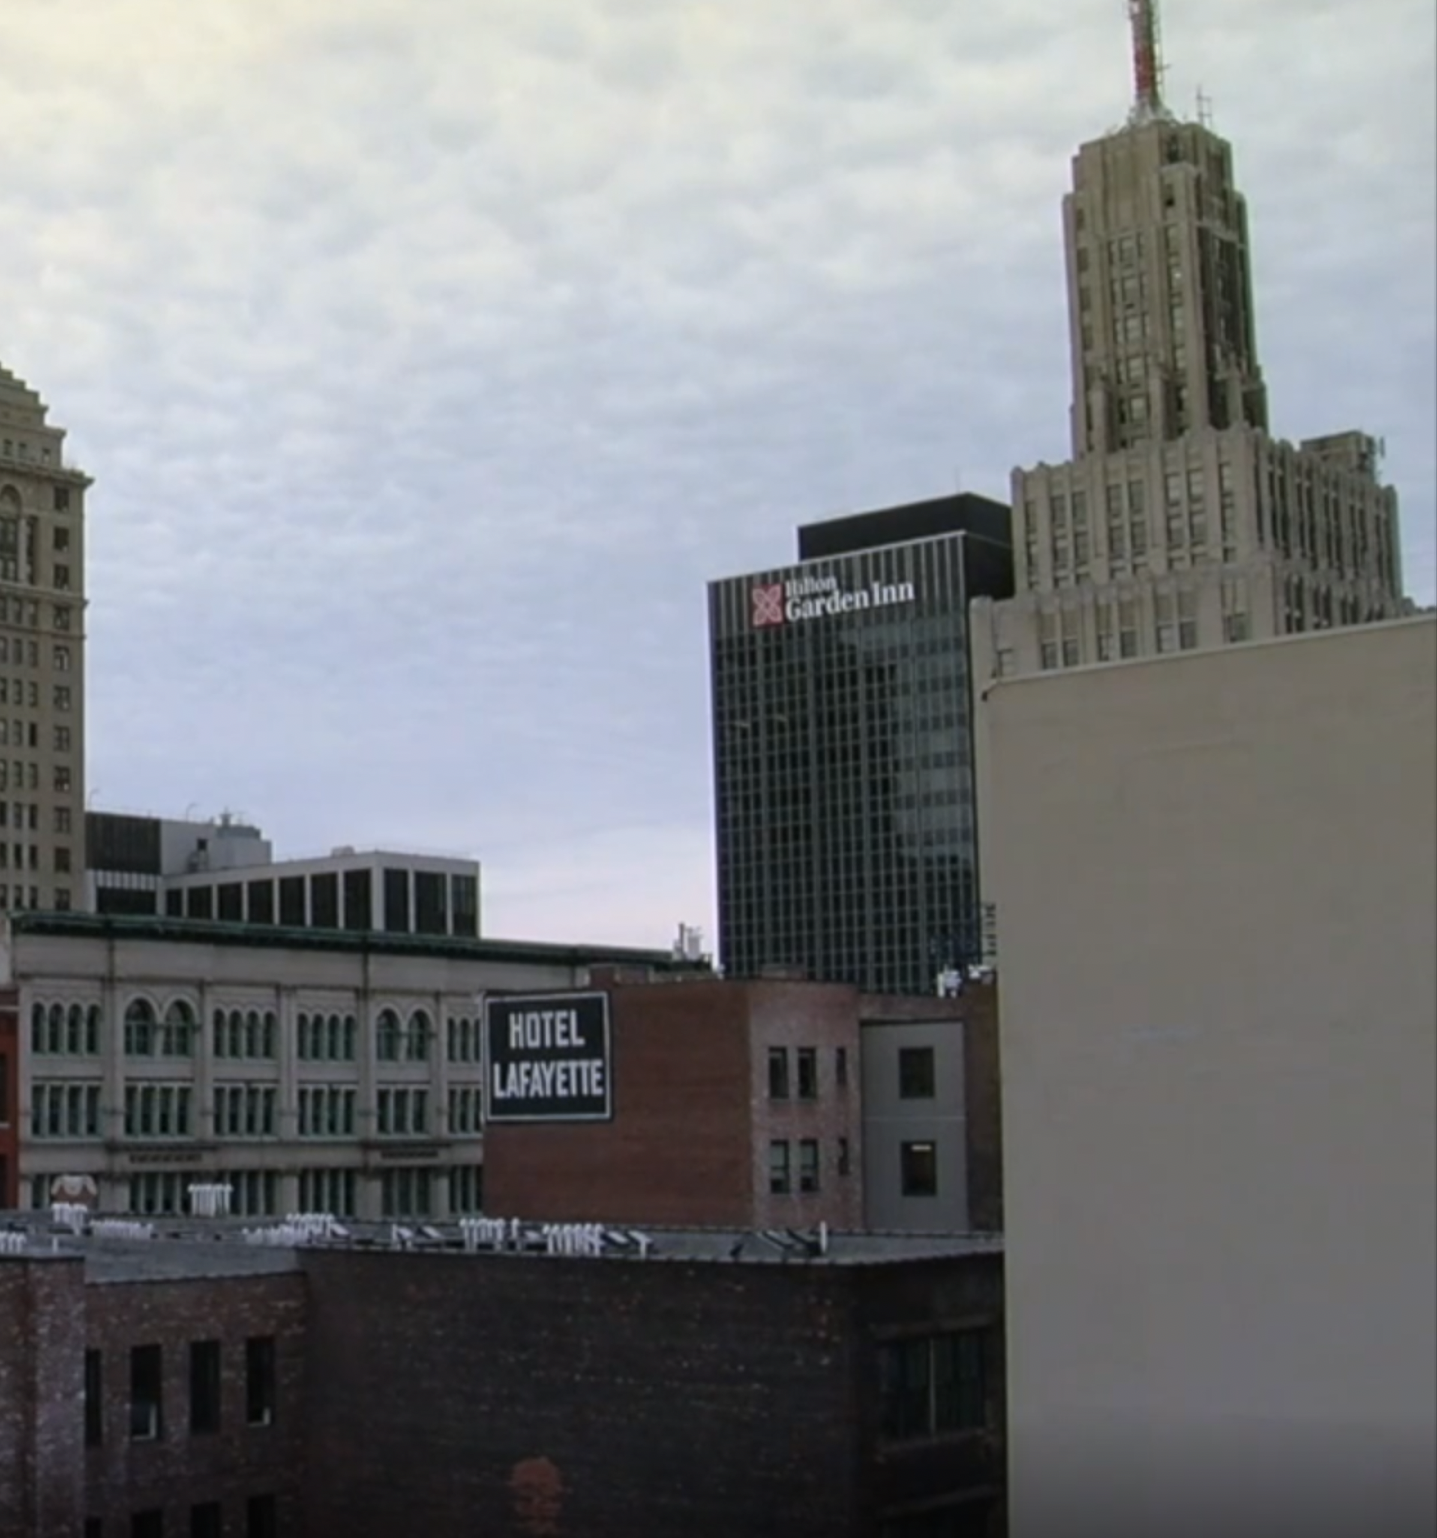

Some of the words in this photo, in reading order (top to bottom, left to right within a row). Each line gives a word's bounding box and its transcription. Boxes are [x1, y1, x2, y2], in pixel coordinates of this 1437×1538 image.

[785, 576, 837, 597] Hilton
[785, 590, 869, 621] Garden
[872, 581, 914, 606] Inn
[509, 1010, 585, 1049] HOTEL
[493, 1059, 604, 1099] LAFAYETTE
